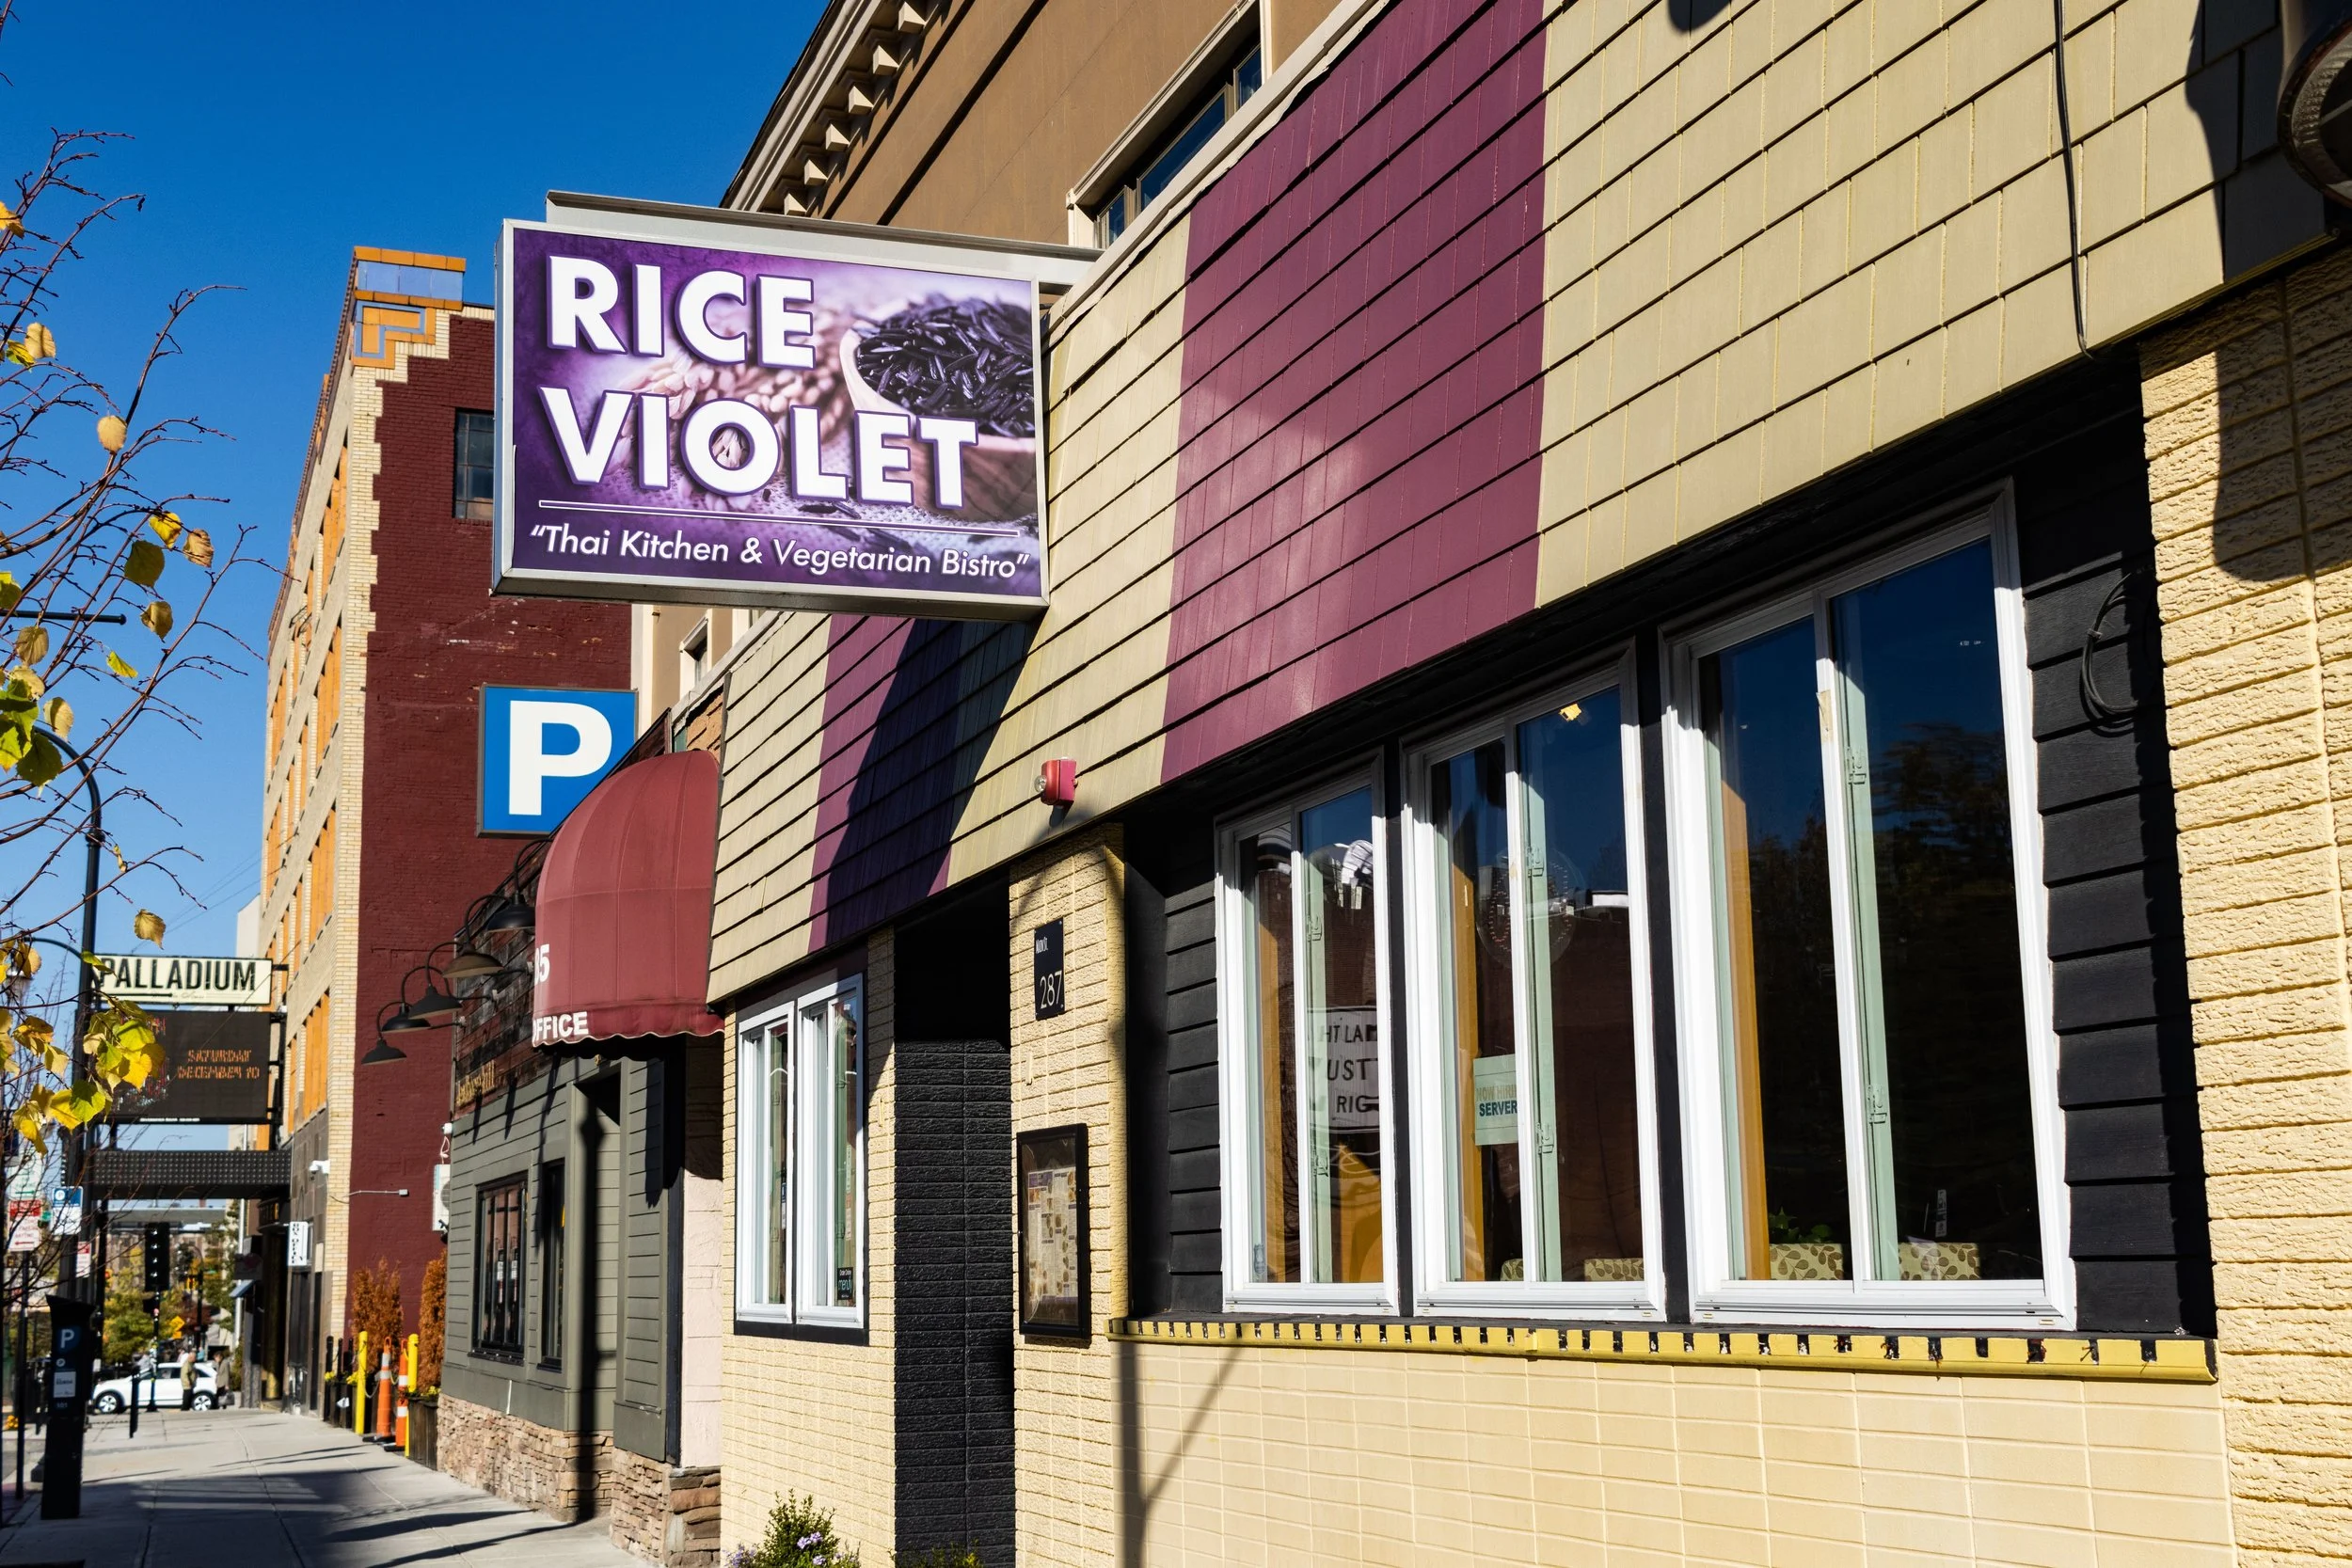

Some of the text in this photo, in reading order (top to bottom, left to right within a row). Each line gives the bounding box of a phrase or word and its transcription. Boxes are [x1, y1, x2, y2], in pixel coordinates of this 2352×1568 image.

[548, 254, 816, 370] RICE
[539, 386, 977, 510] VIOLET
[531, 523, 1030, 579] “Thai Kitchen & Vegetarian Bistro”
[508, 700, 612, 816] P
[100, 958, 256, 991] PALLADIUM
[1040, 970, 1062, 1009] 287
[60, 1328, 75, 1349] P
